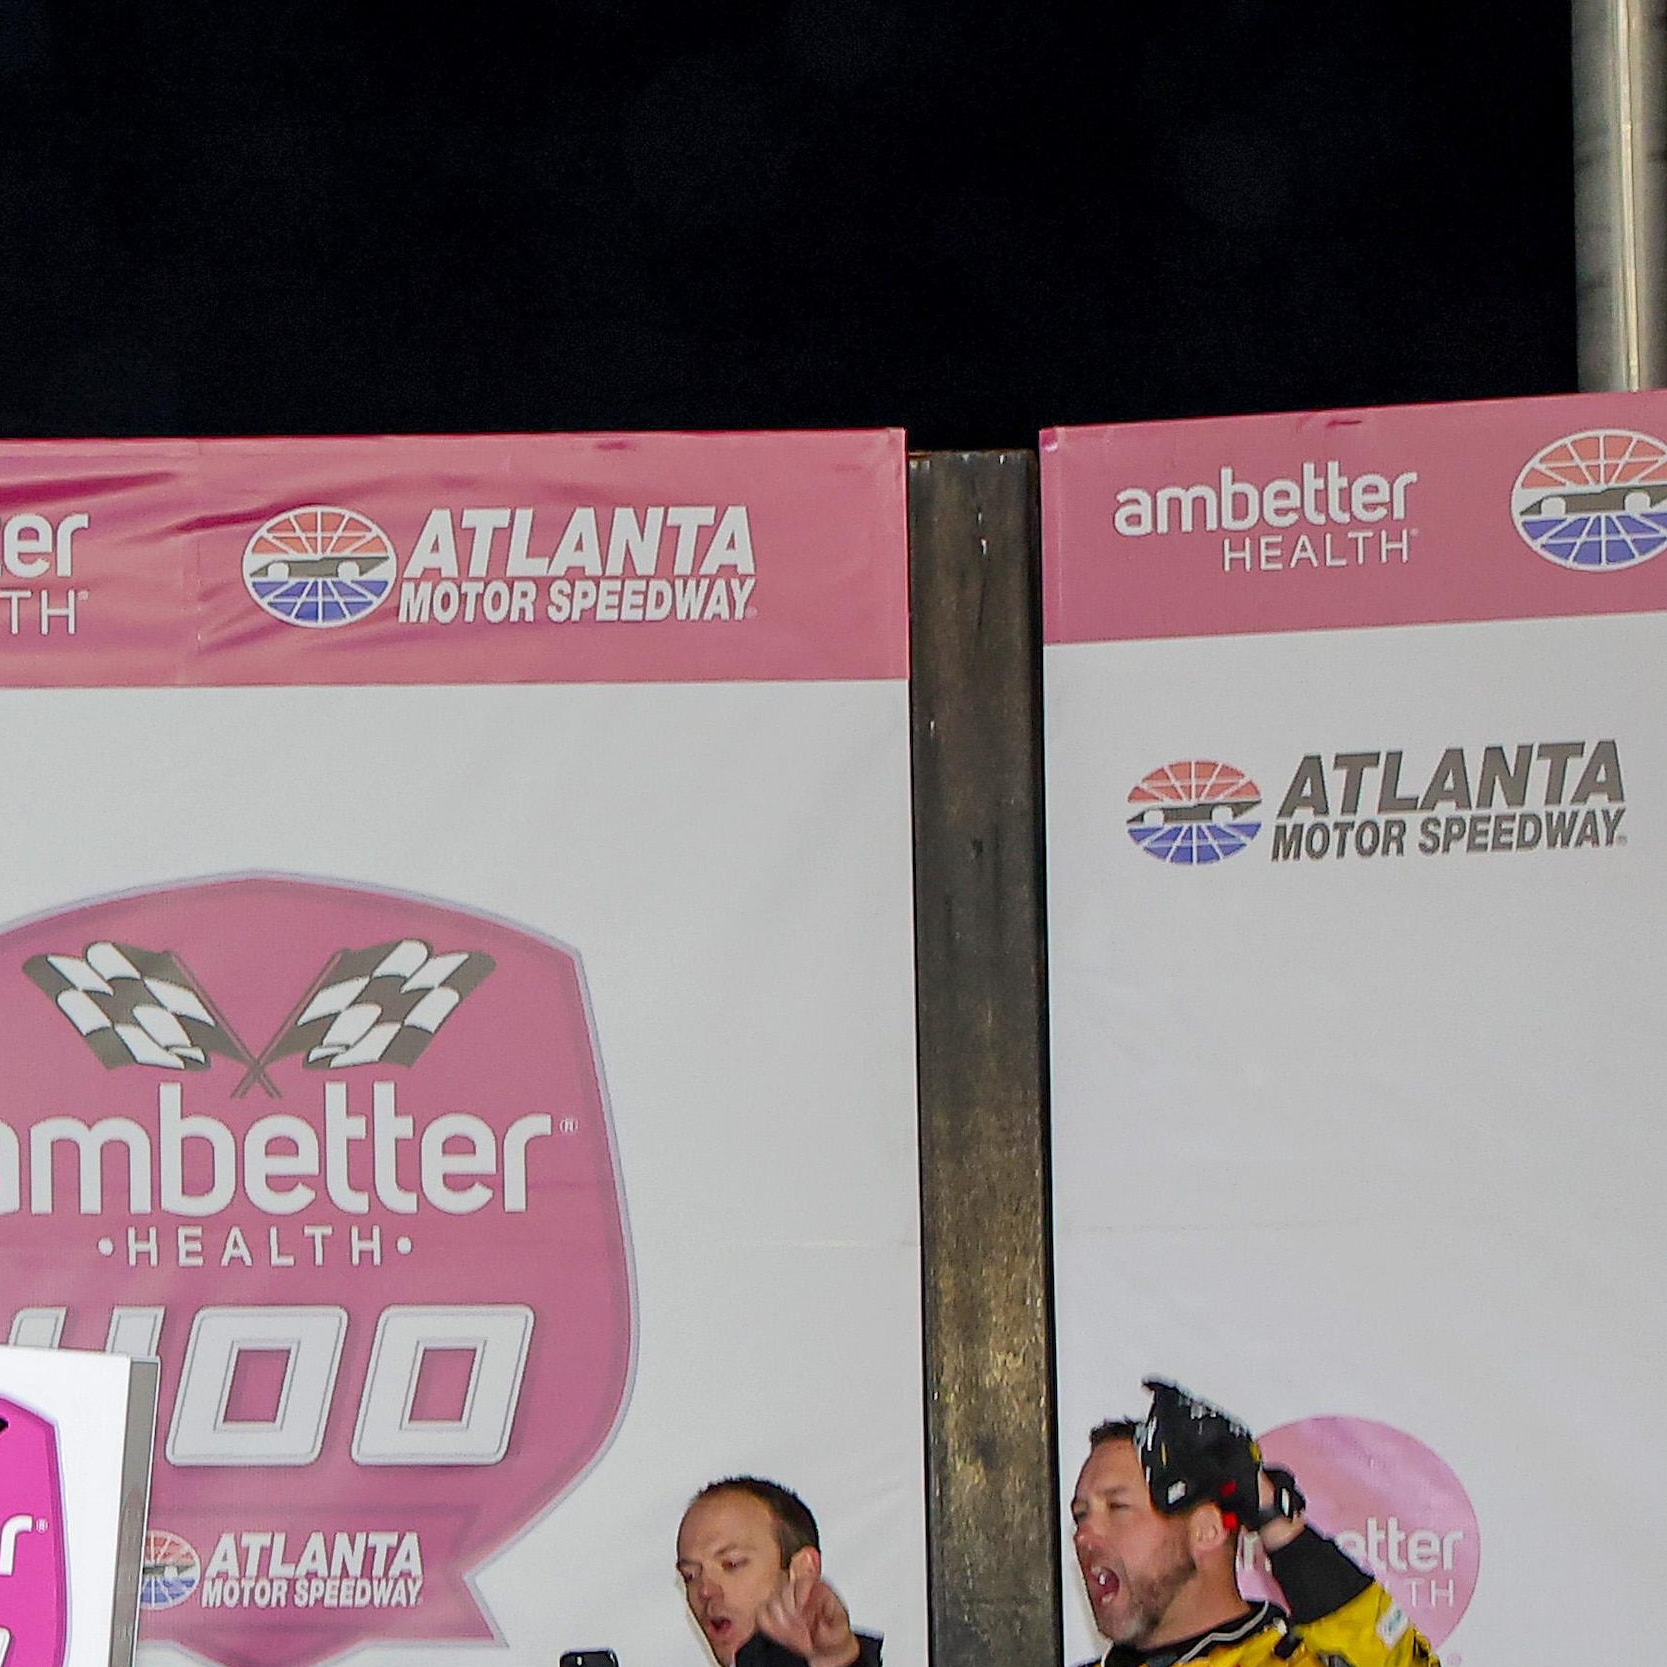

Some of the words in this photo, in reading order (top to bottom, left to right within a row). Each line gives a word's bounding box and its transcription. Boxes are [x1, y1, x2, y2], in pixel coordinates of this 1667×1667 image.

[1113, 460, 1418, 537] ambetter
[403, 505, 757, 579] ATLANTA
[1223, 528, 1410, 572] HEALTH
[398, 579, 536, 624] MOTOR
[546, 577, 757, 623] SPEEDWAY
[1275, 739, 1626, 818] ATLANTA
[1270, 817, 1407, 863] MOTOR
[1418, 806, 1627, 855] SPEEDWAY
[126, 1225, 385, 1269] HEALTH
[207, 1531, 423, 1580] ATLANTA
[200, 1577, 288, 1609] MOTOR
[292, 1577, 424, 1609] SPEEDWAY
